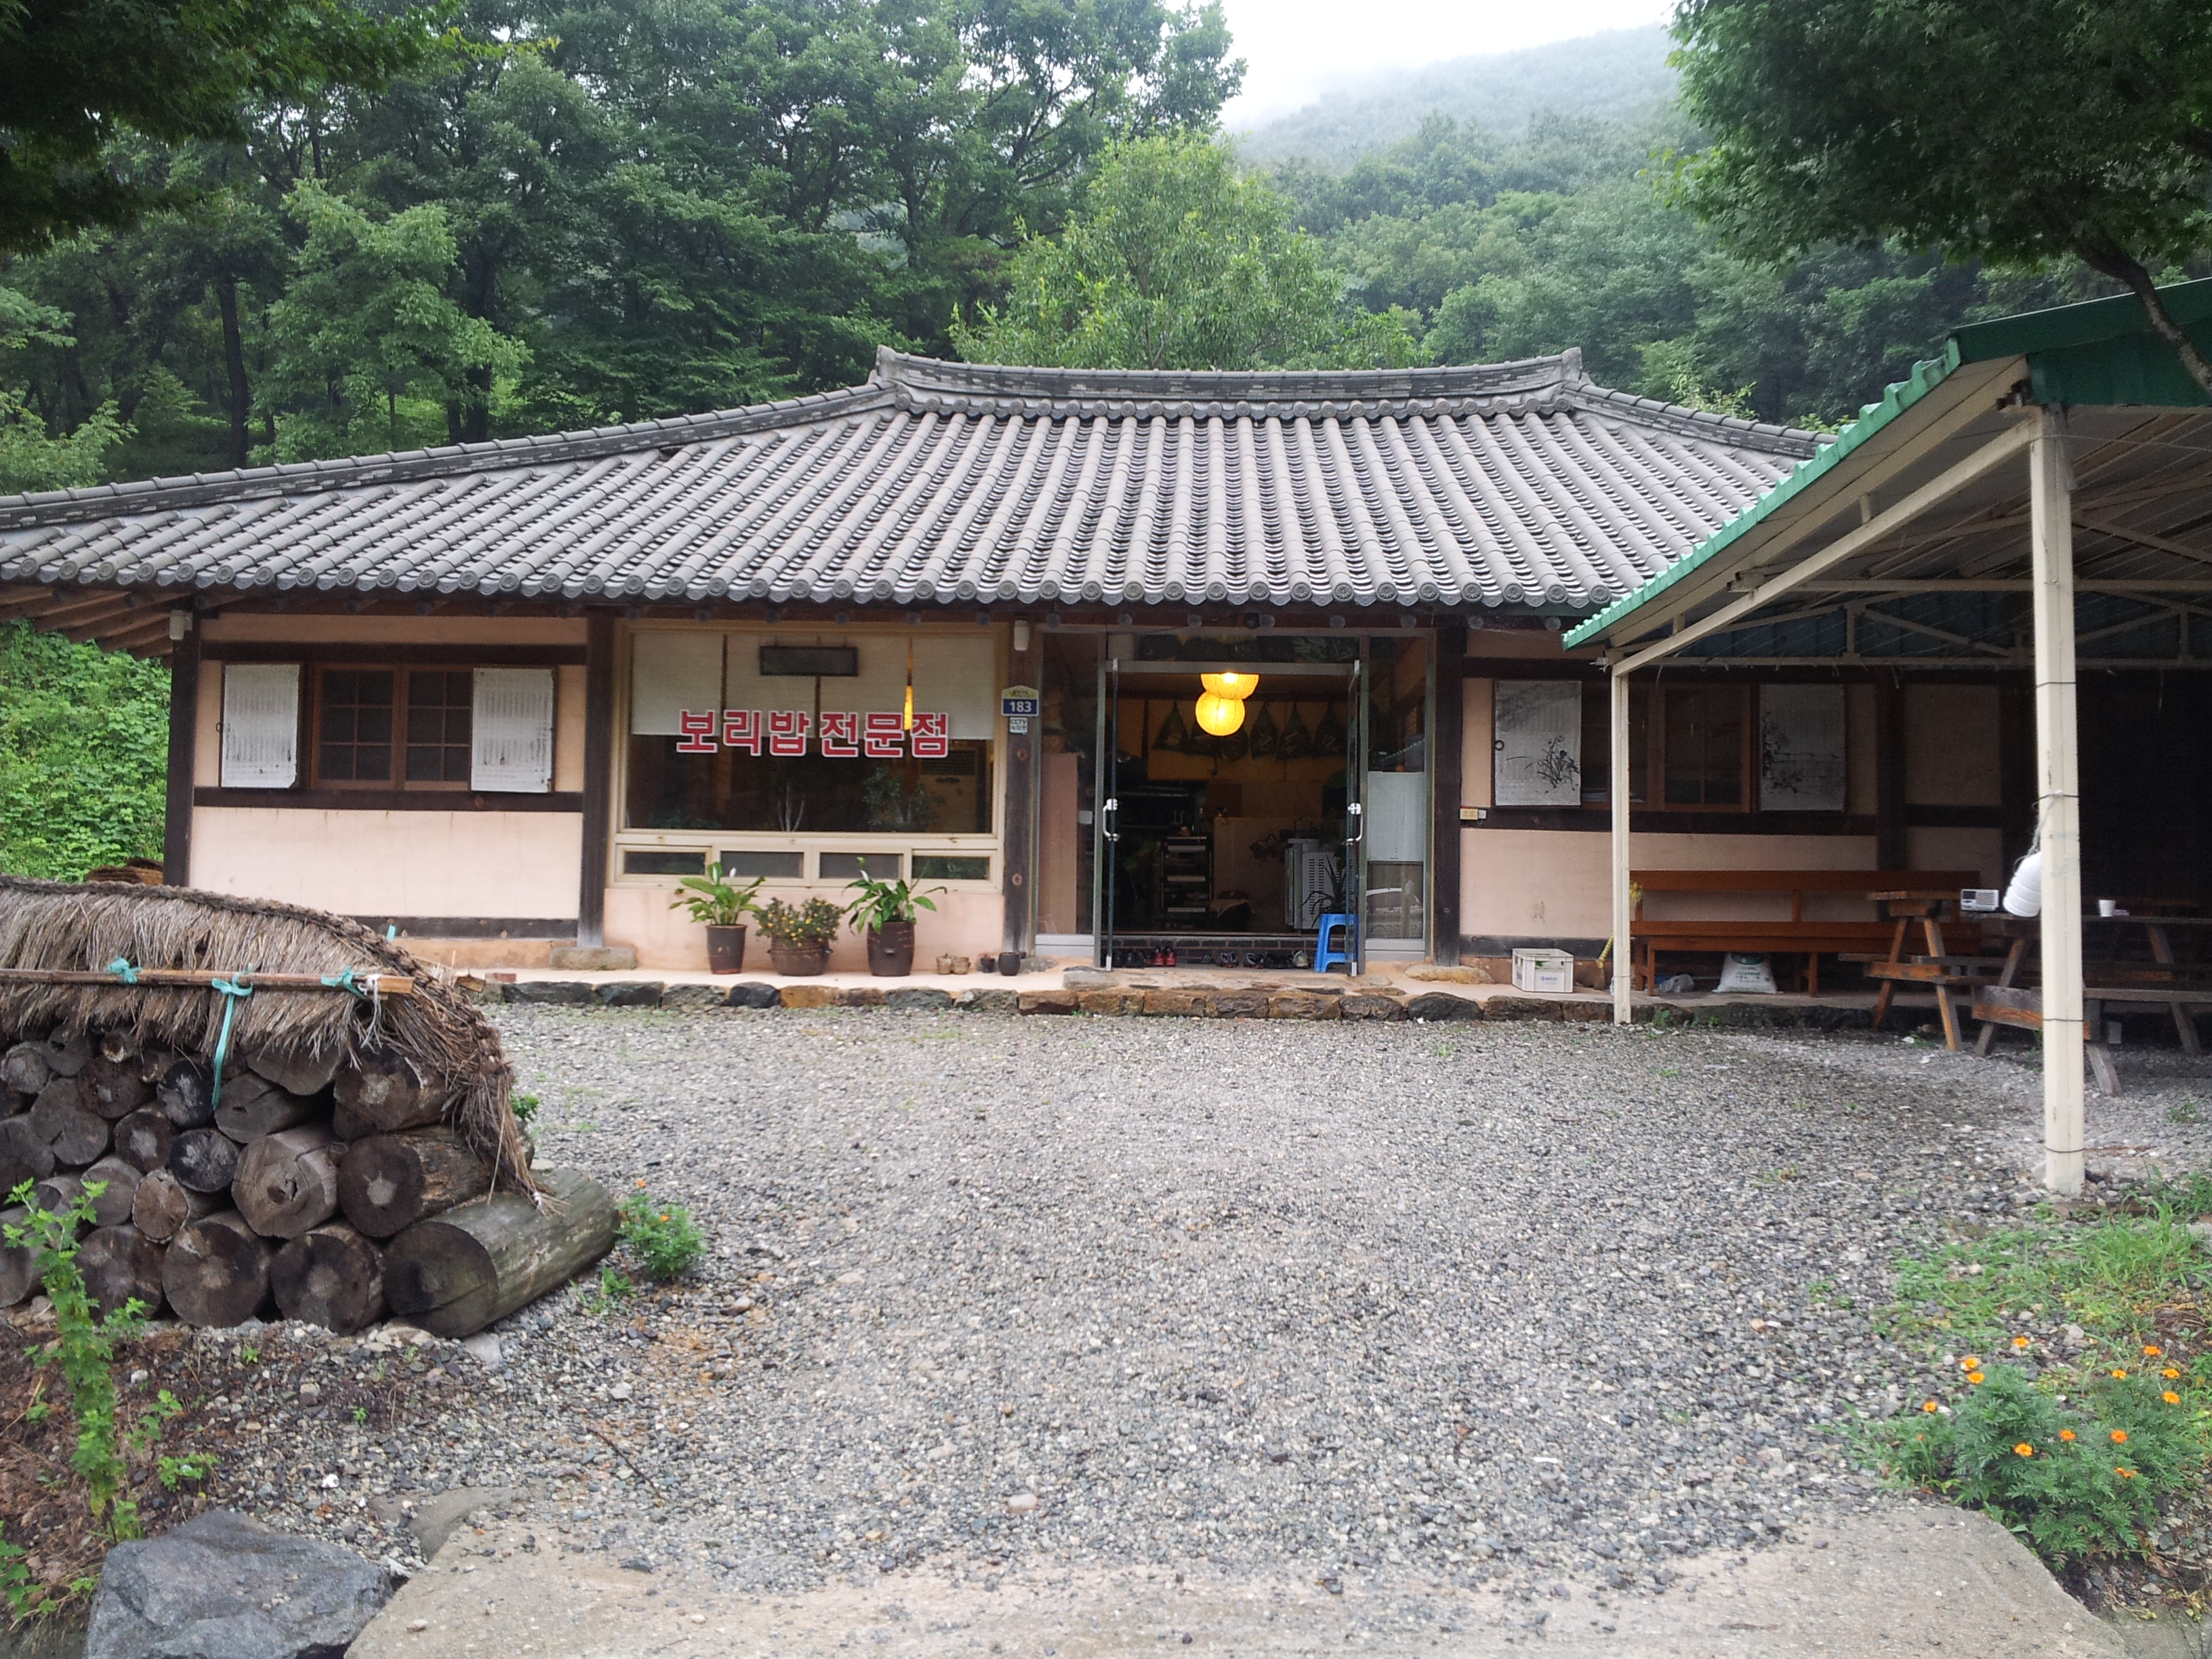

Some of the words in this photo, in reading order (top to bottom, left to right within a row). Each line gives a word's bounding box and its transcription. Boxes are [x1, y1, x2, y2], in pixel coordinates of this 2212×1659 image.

[1010, 701, 1032, 713] 183
[676, 710, 811, 756] 보리밥
[820, 712, 949, 758] 전문점
